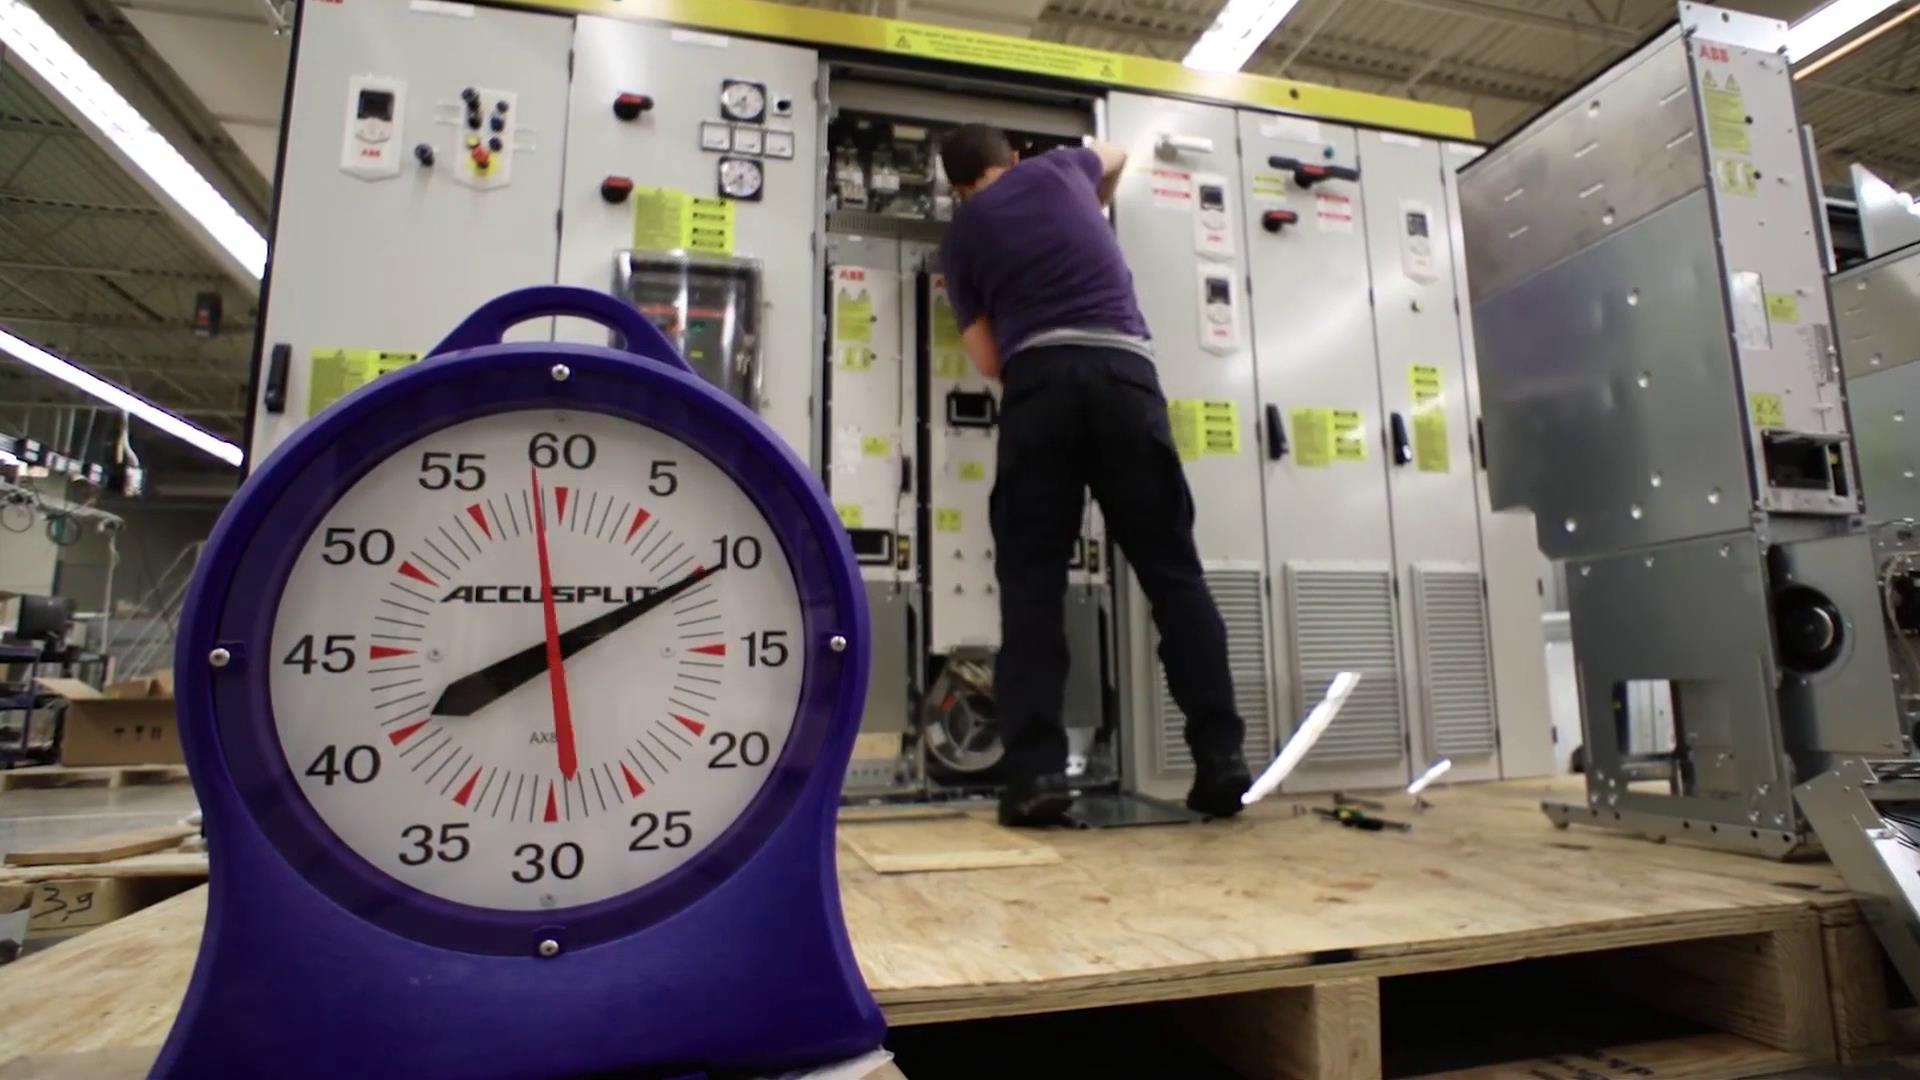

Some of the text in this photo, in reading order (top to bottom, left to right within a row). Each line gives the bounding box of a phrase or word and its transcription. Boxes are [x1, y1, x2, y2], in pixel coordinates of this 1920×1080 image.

[1699, 43, 1729, 63] ABB
[527, 430, 598, 471] 60
[417, 451, 487, 492] 55
[648, 459, 679, 497] 5
[320, 526, 397, 568] 50
[712, 534, 763, 571] 10
[440, 585, 660, 604] ACCUSPLIT
[281, 633, 358, 676] 45
[740, 631, 790, 669] 15
[303, 744, 382, 788] 40
[707, 731, 771, 770] 20
[397, 822, 471, 868] 35
[628, 811, 694, 852] 25
[511, 841, 586, 885] 30
